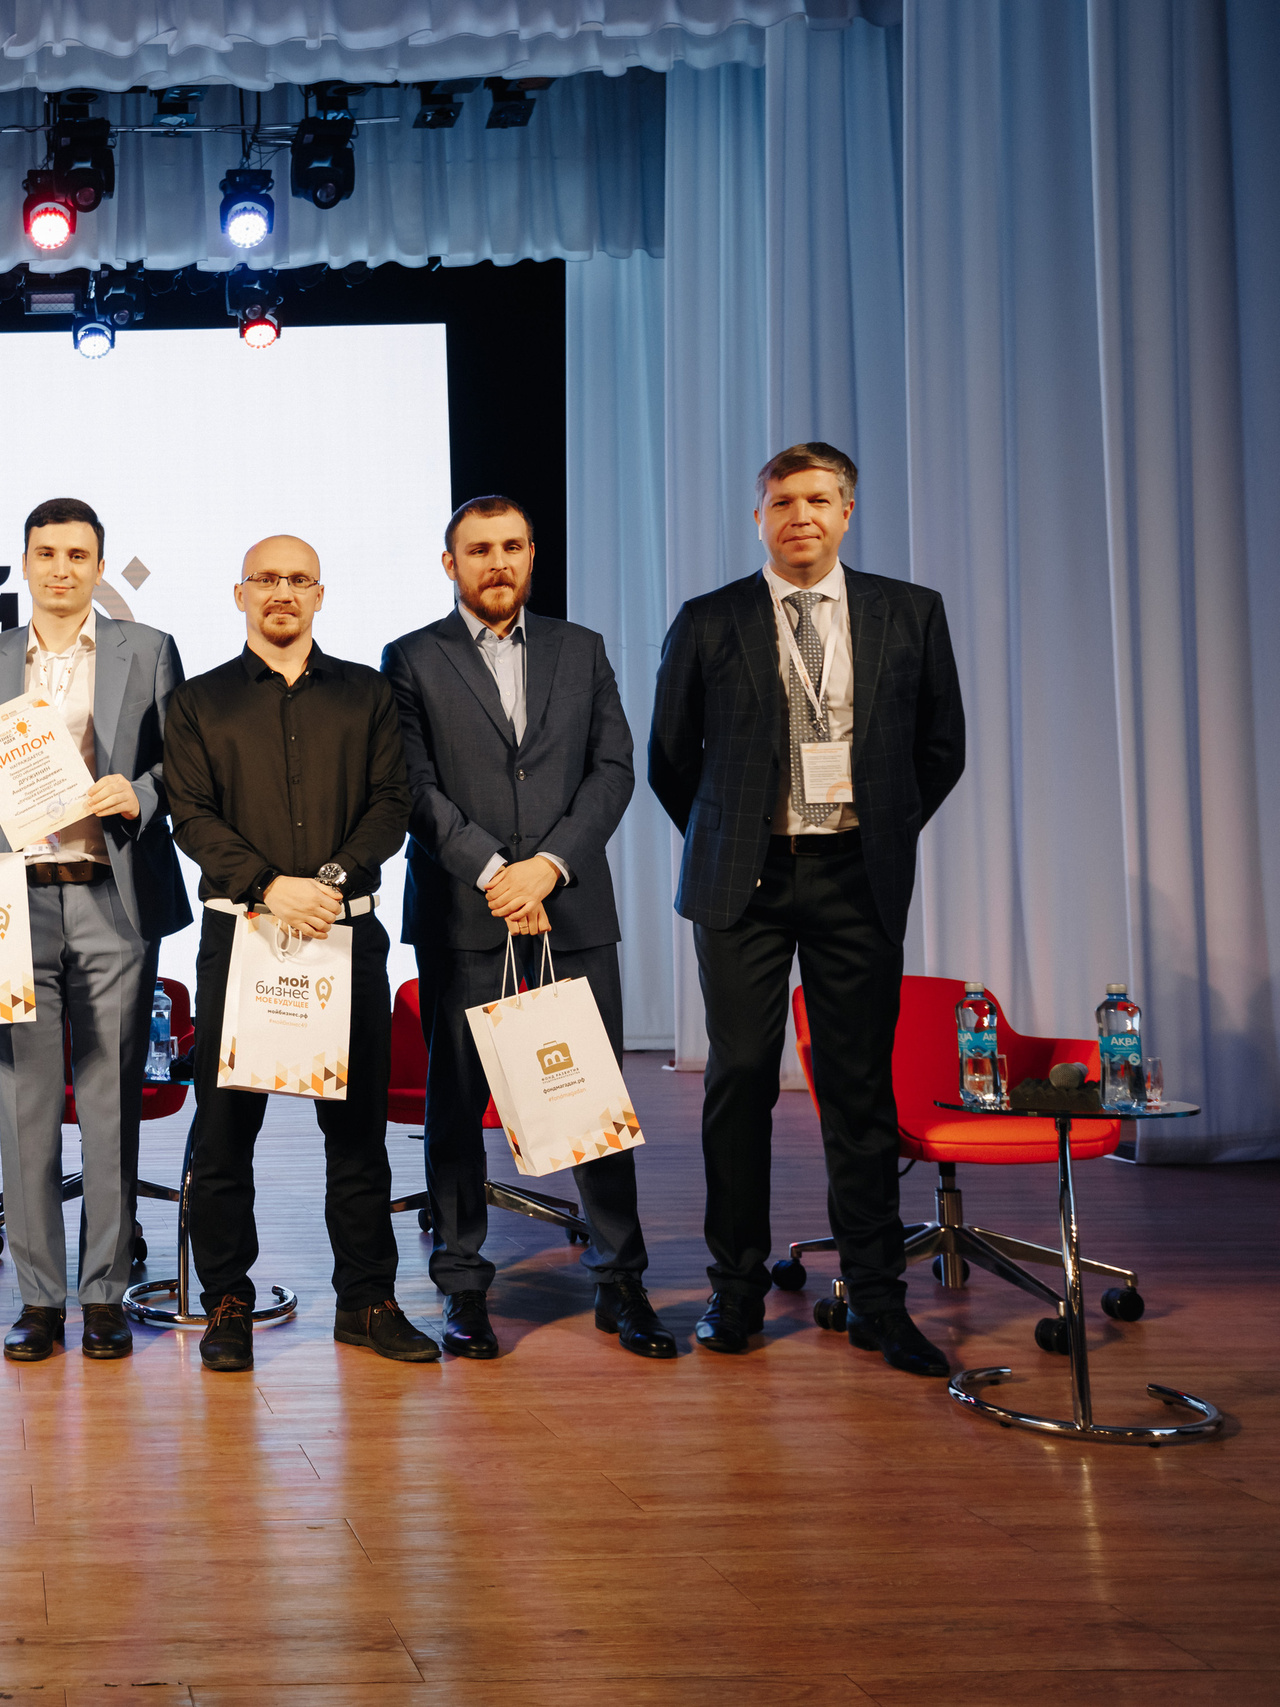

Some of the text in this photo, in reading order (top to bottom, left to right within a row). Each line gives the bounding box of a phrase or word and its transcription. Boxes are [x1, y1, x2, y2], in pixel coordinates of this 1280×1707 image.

[278, 975, 309, 989] мой
[255, 980, 309, 1000] бизнес
[255, 996, 309, 1009] МОЕ БУДУЩЕЕ
[1110, 1036, 1139, 1047] АКВА
